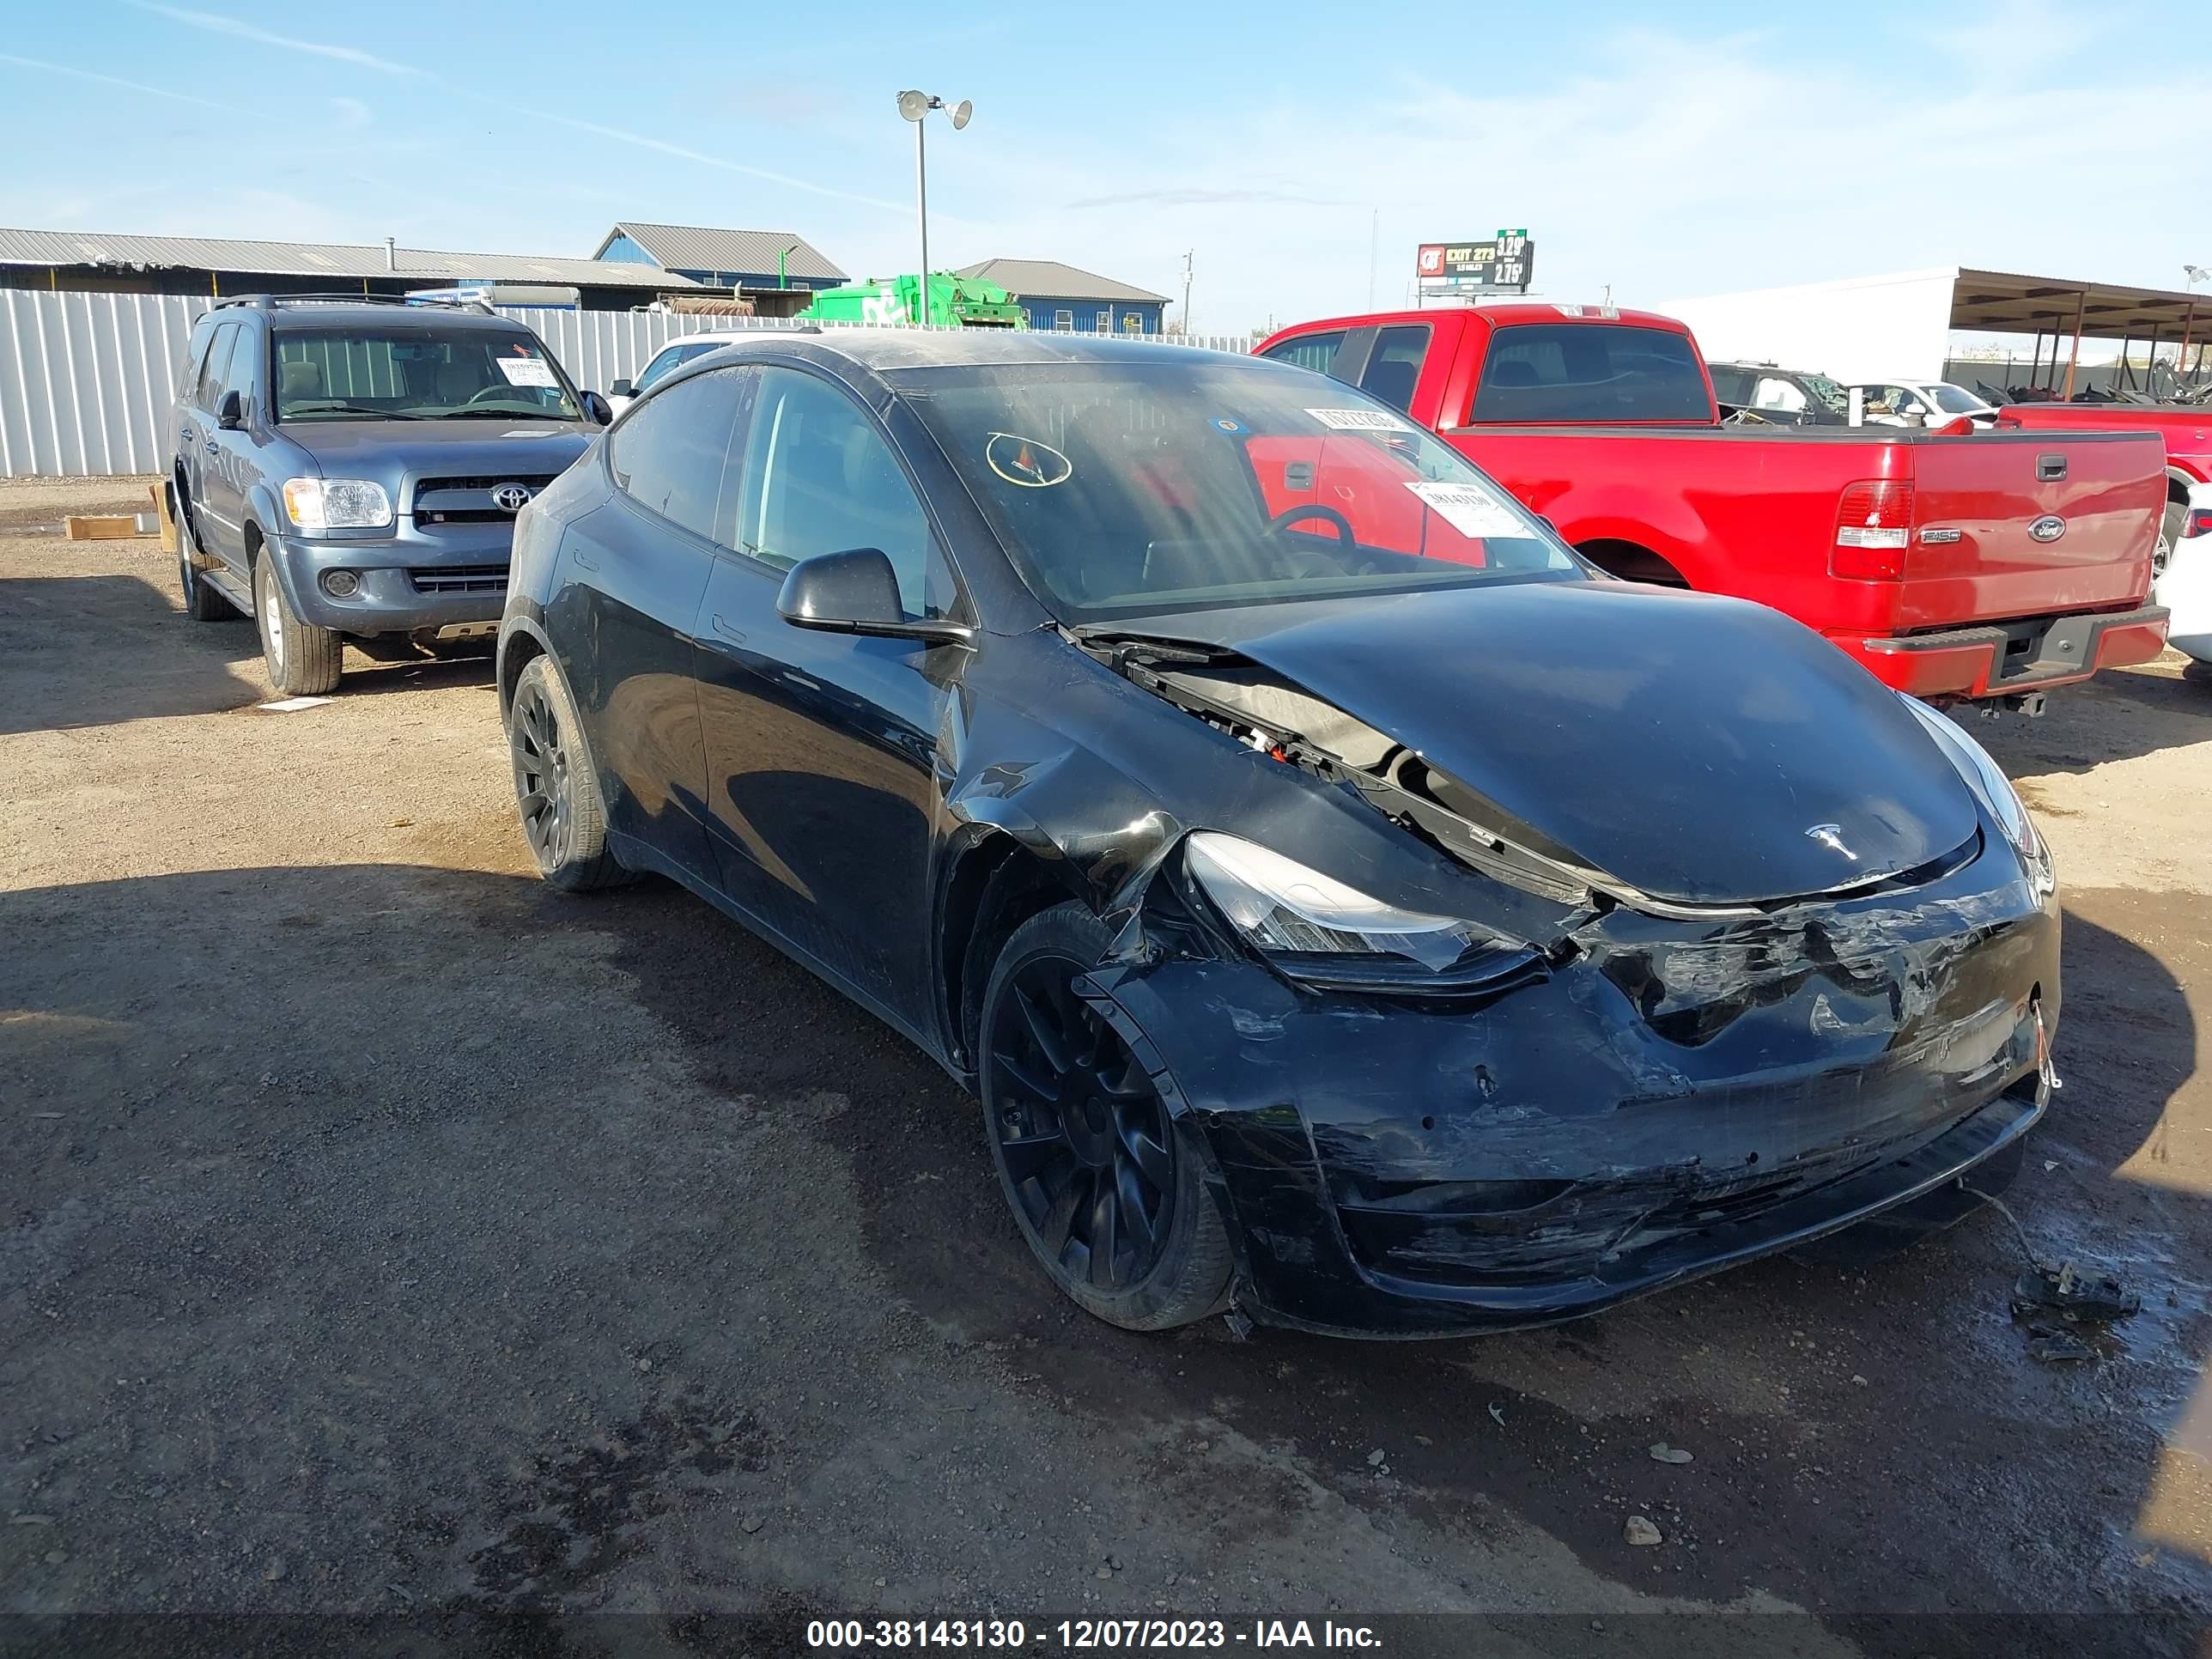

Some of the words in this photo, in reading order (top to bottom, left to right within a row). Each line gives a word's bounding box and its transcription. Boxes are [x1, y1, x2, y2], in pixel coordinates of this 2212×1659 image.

[1445, 248, 1473, 262] EXIT
[1473, 247, 1495, 261] 273
[2039, 521, 2059, 537] Ford
